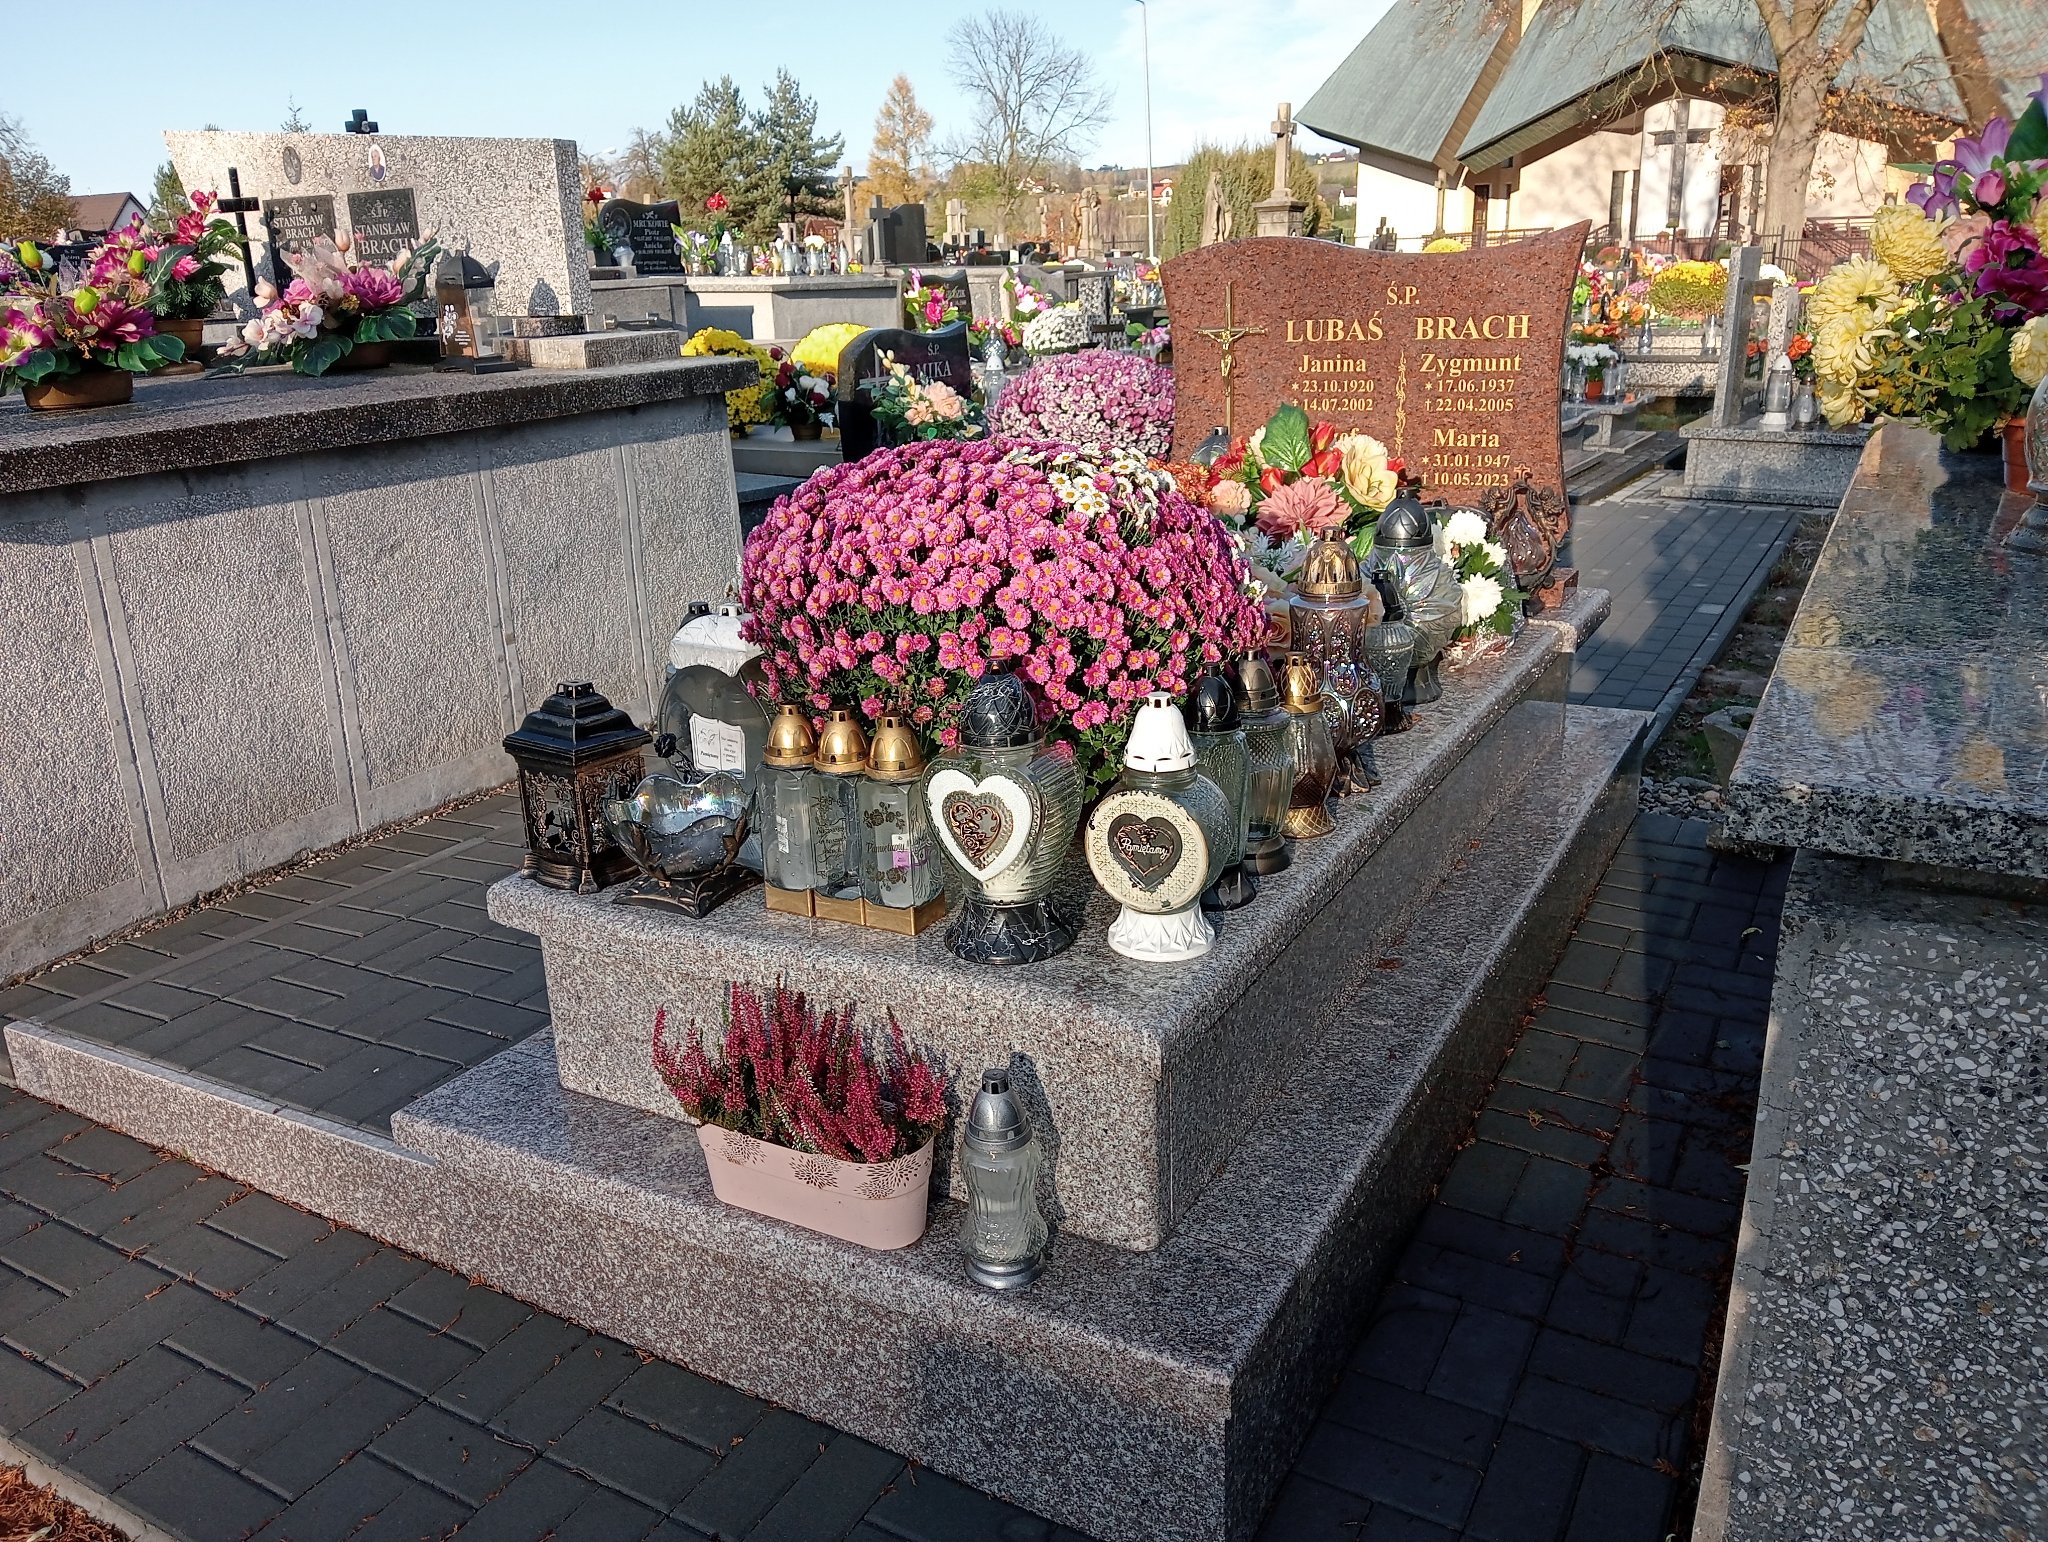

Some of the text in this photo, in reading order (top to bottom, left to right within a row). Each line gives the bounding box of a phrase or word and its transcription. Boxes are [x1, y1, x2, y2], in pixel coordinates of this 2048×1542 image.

[273, 214, 324, 229] STANISŁAW
[285, 226, 316, 240] BRACH
[354, 222, 410, 237] STANISŁAW
[361, 238, 410, 256] BRACH
[1386, 280, 1420, 306] Ś.P.
[1285, 310, 1532, 343] LUBAŚ BRACH
[1298, 354, 1367, 374] Janina
[1419, 353, 1522, 377] Zygmunt
[1302, 379, 1375, 393] 23.10.1920
[1437, 379, 1515, 393] 17.06.1937
[1303, 398, 1374, 412] 14.07.2002
[1435, 398, 1514, 412] 22.04.2005
[1432, 428, 1500, 448] Maria
[1432, 454, 1511, 468] 31.01.1947
[1434, 472, 1509, 487] 10.05.2023
